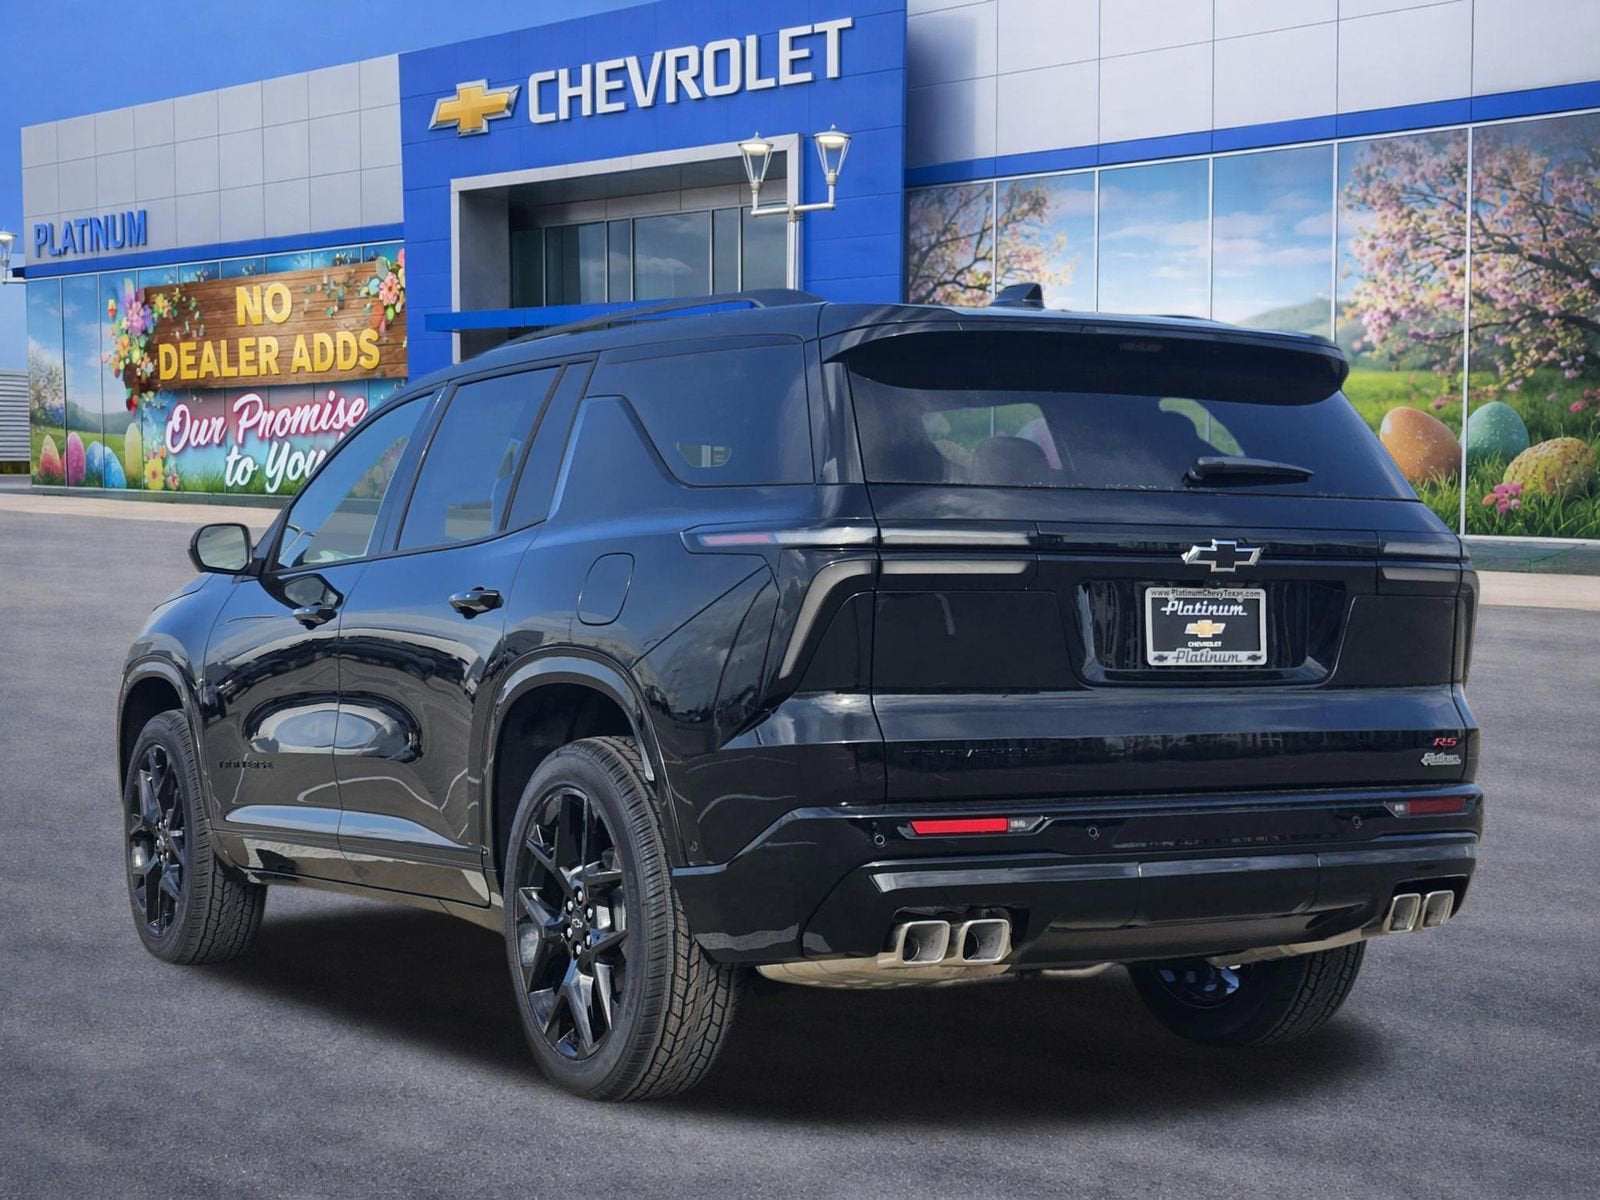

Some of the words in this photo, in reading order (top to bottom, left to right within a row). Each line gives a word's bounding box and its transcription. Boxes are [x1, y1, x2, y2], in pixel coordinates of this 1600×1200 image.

[528, 16, 854, 124] CHEVROLET
[34, 209, 147, 258] PLATINUM
[236, 282, 293, 325] NO
[159, 336, 280, 380] DEALER
[291, 330, 381, 373] ADDS
[165, 402, 228, 454] Our
[233, 390, 369, 444] Promise
[225, 445, 258, 487] to
[1160, 600, 1248, 616] Platinum
[1173, 649, 1243, 663] Platinum
[1433, 737, 1457, 746] RS
